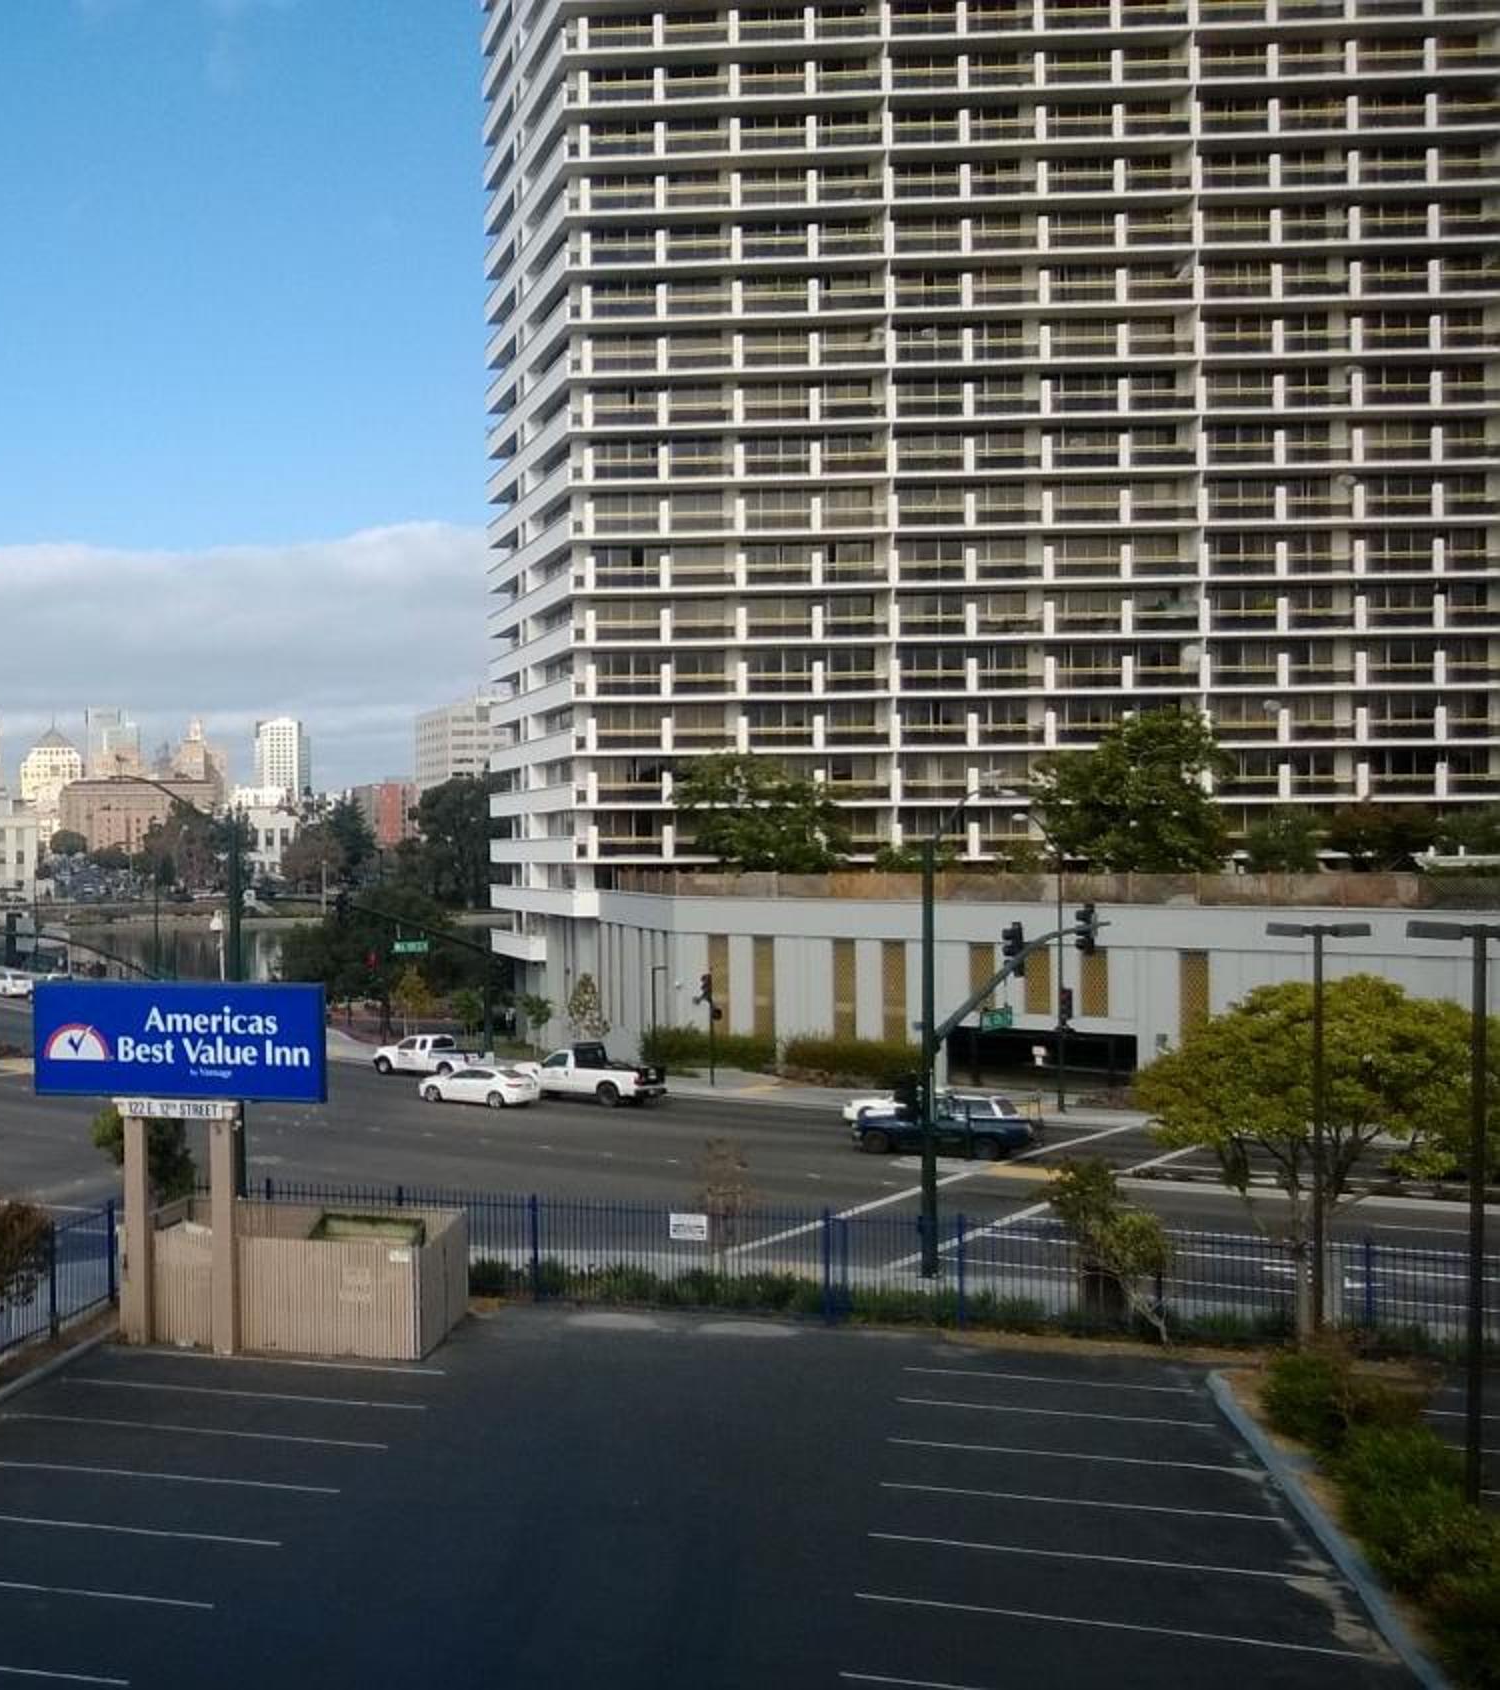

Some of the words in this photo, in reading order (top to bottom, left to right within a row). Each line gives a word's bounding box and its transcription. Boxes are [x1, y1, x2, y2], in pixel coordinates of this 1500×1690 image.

[144, 1005, 278, 1035] Americas
[117, 1037, 175, 1064] Best
[182, 1037, 257, 1066] Value
[265, 1040, 311, 1067] Inn
[129, 1101, 144, 1115] 122
[180, 1102, 219, 1117] STREET
